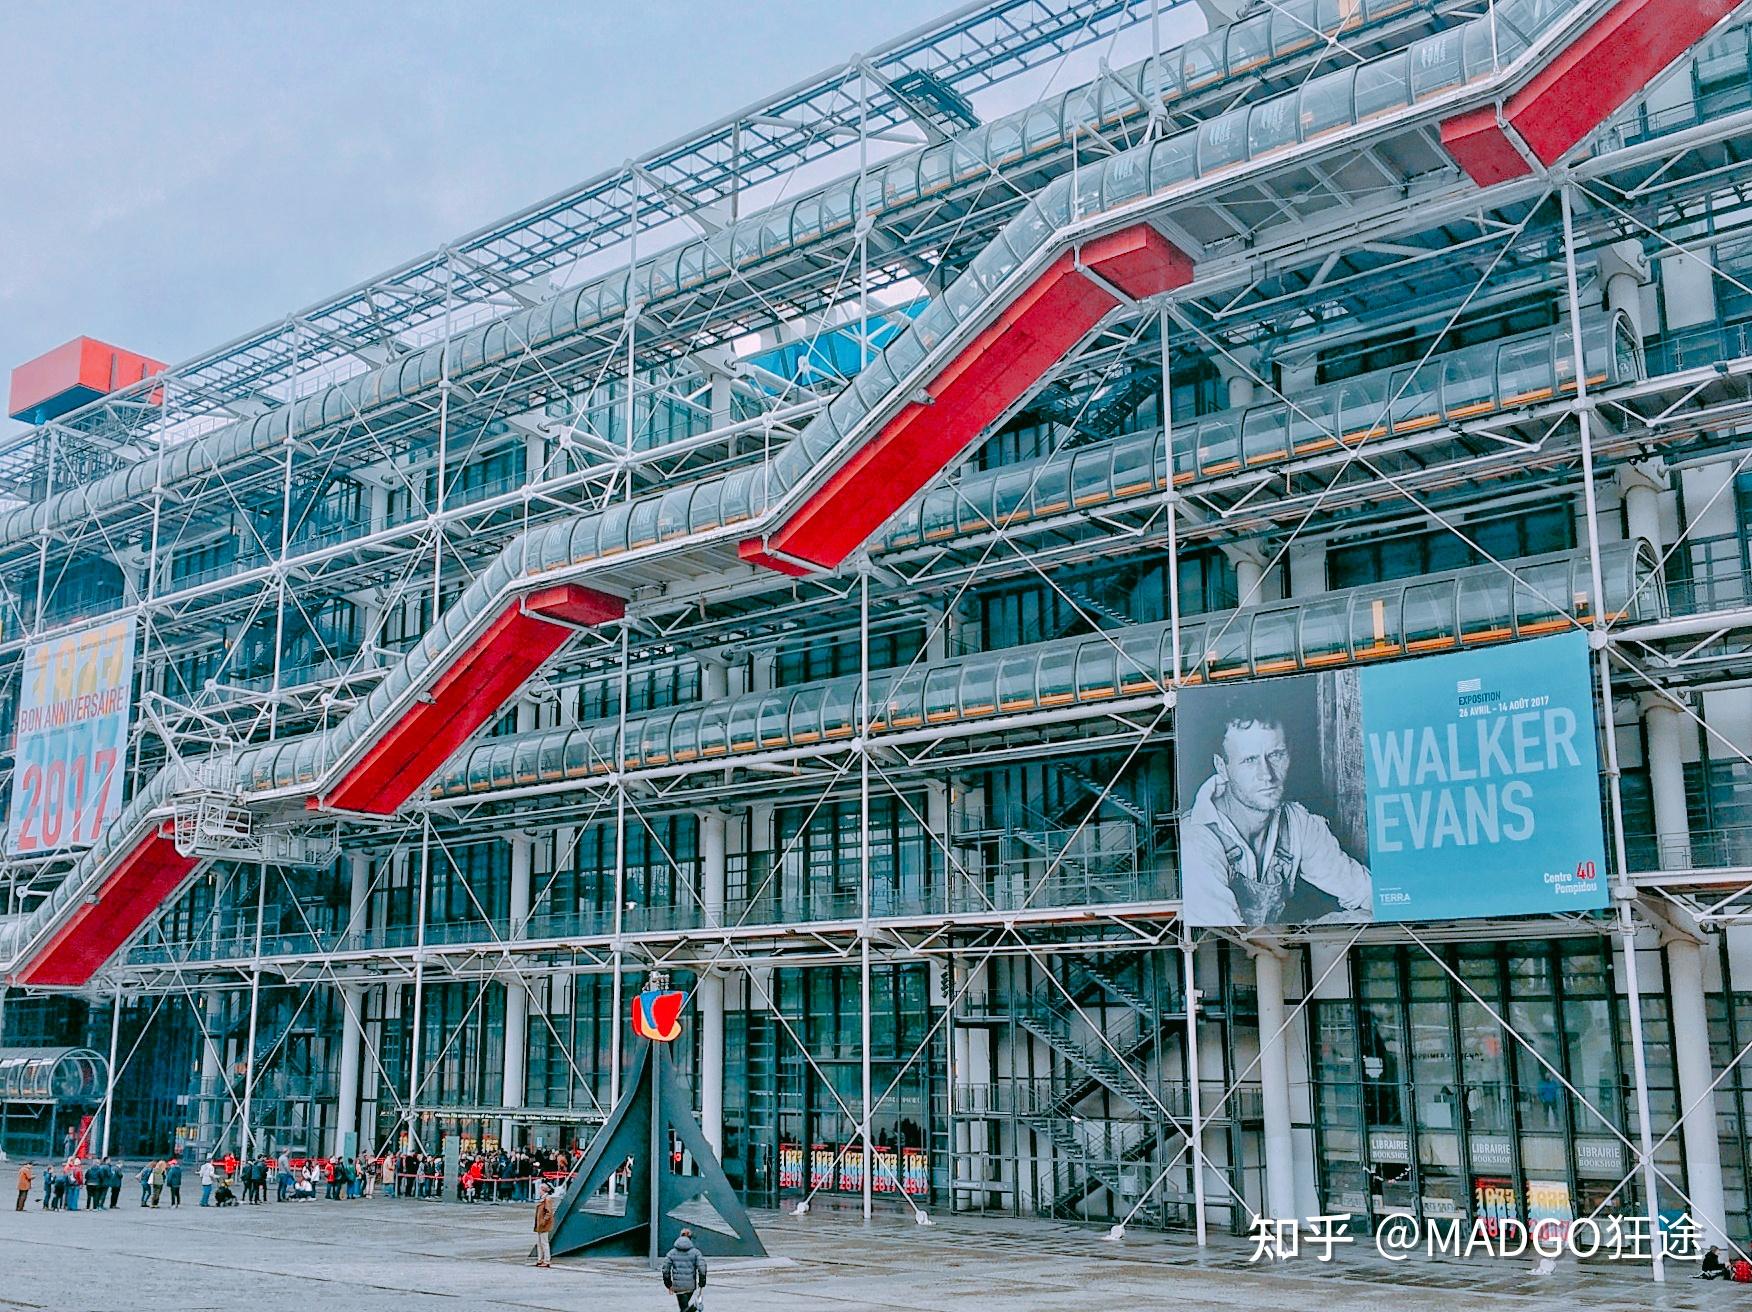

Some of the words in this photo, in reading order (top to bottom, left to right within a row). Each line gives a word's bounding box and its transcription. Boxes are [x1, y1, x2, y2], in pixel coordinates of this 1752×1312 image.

[33, 622, 127, 703] 1977
[1458, 691, 1501, 706] EXPOSITION
[1459, 708, 1468, 718] 26
[1470, 704, 1491, 716] AVRIL
[1499, 702, 1508, 712] 14
[1509, 697, 1530, 710] AOÛT
[1531, 695, 1550, 707] 2017
[19, 706, 42, 734] BON
[1369, 707, 1581, 788] WALKER
[17, 747, 117, 850] 2017
[1375, 781, 1535, 852] EVANS
[1543, 872, 1572, 883] Centre
[1576, 861, 1596, 880] 40
[1555, 880, 1597, 895] Pompidou
[1379, 893, 1411, 903] TERRA
[1372, 1139, 1408, 1150] LIBRAIRIE
[1472, 1143, 1510, 1154] LIBRAIRIE
[1473, 1154, 1511, 1164] BOOKSHOP
[1578, 1147, 1619, 1158] LIBRAIRIE
[1579, 1158, 1620, 1168] BOOKSHOP
